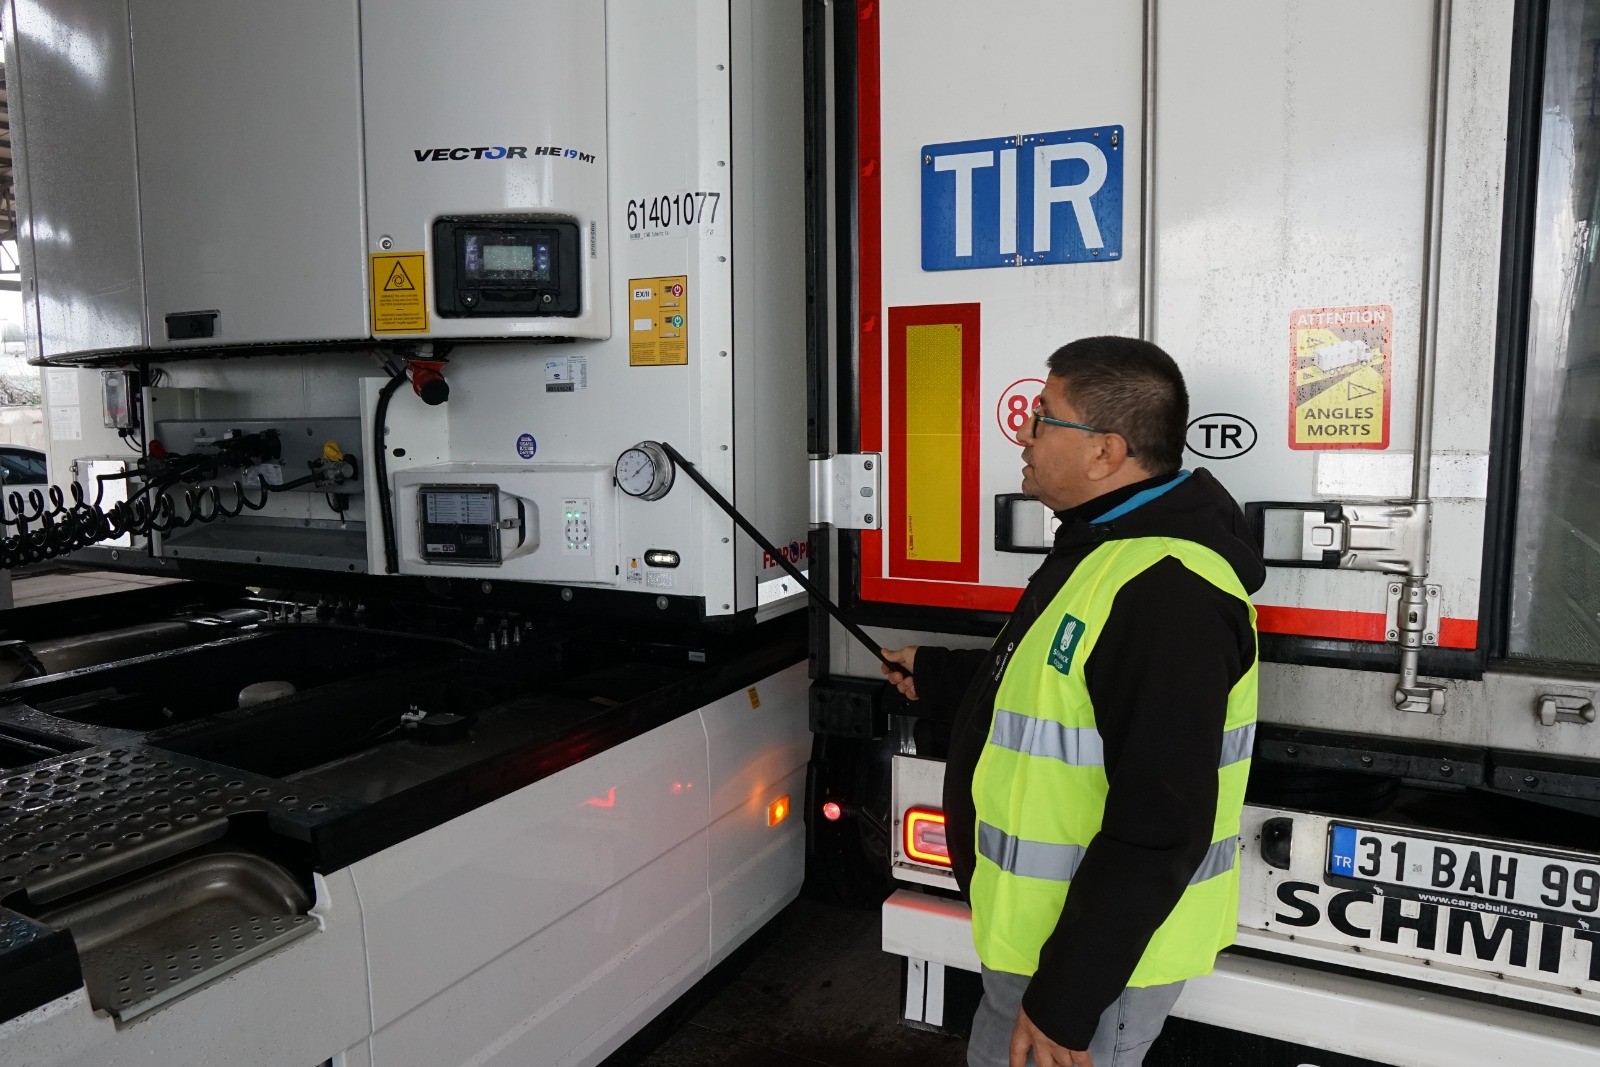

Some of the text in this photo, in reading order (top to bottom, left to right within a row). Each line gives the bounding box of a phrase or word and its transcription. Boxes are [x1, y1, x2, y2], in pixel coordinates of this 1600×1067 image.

[414, 146, 527, 162] VECTOR
[934, 141, 1108, 257] TIR
[627, 192, 720, 231] 61401077
[1297, 309, 1386, 326] ATTENTION
[1304, 407, 1374, 420] ANGLES
[1198, 424, 1243, 449] TR
[1307, 424, 1371, 436] MORTS
[1334, 854, 1352, 869] TR
[1358, 836, 1600, 913] 31 BAH 99
[1418, 893, 1538, 919] www.cargobull.com
